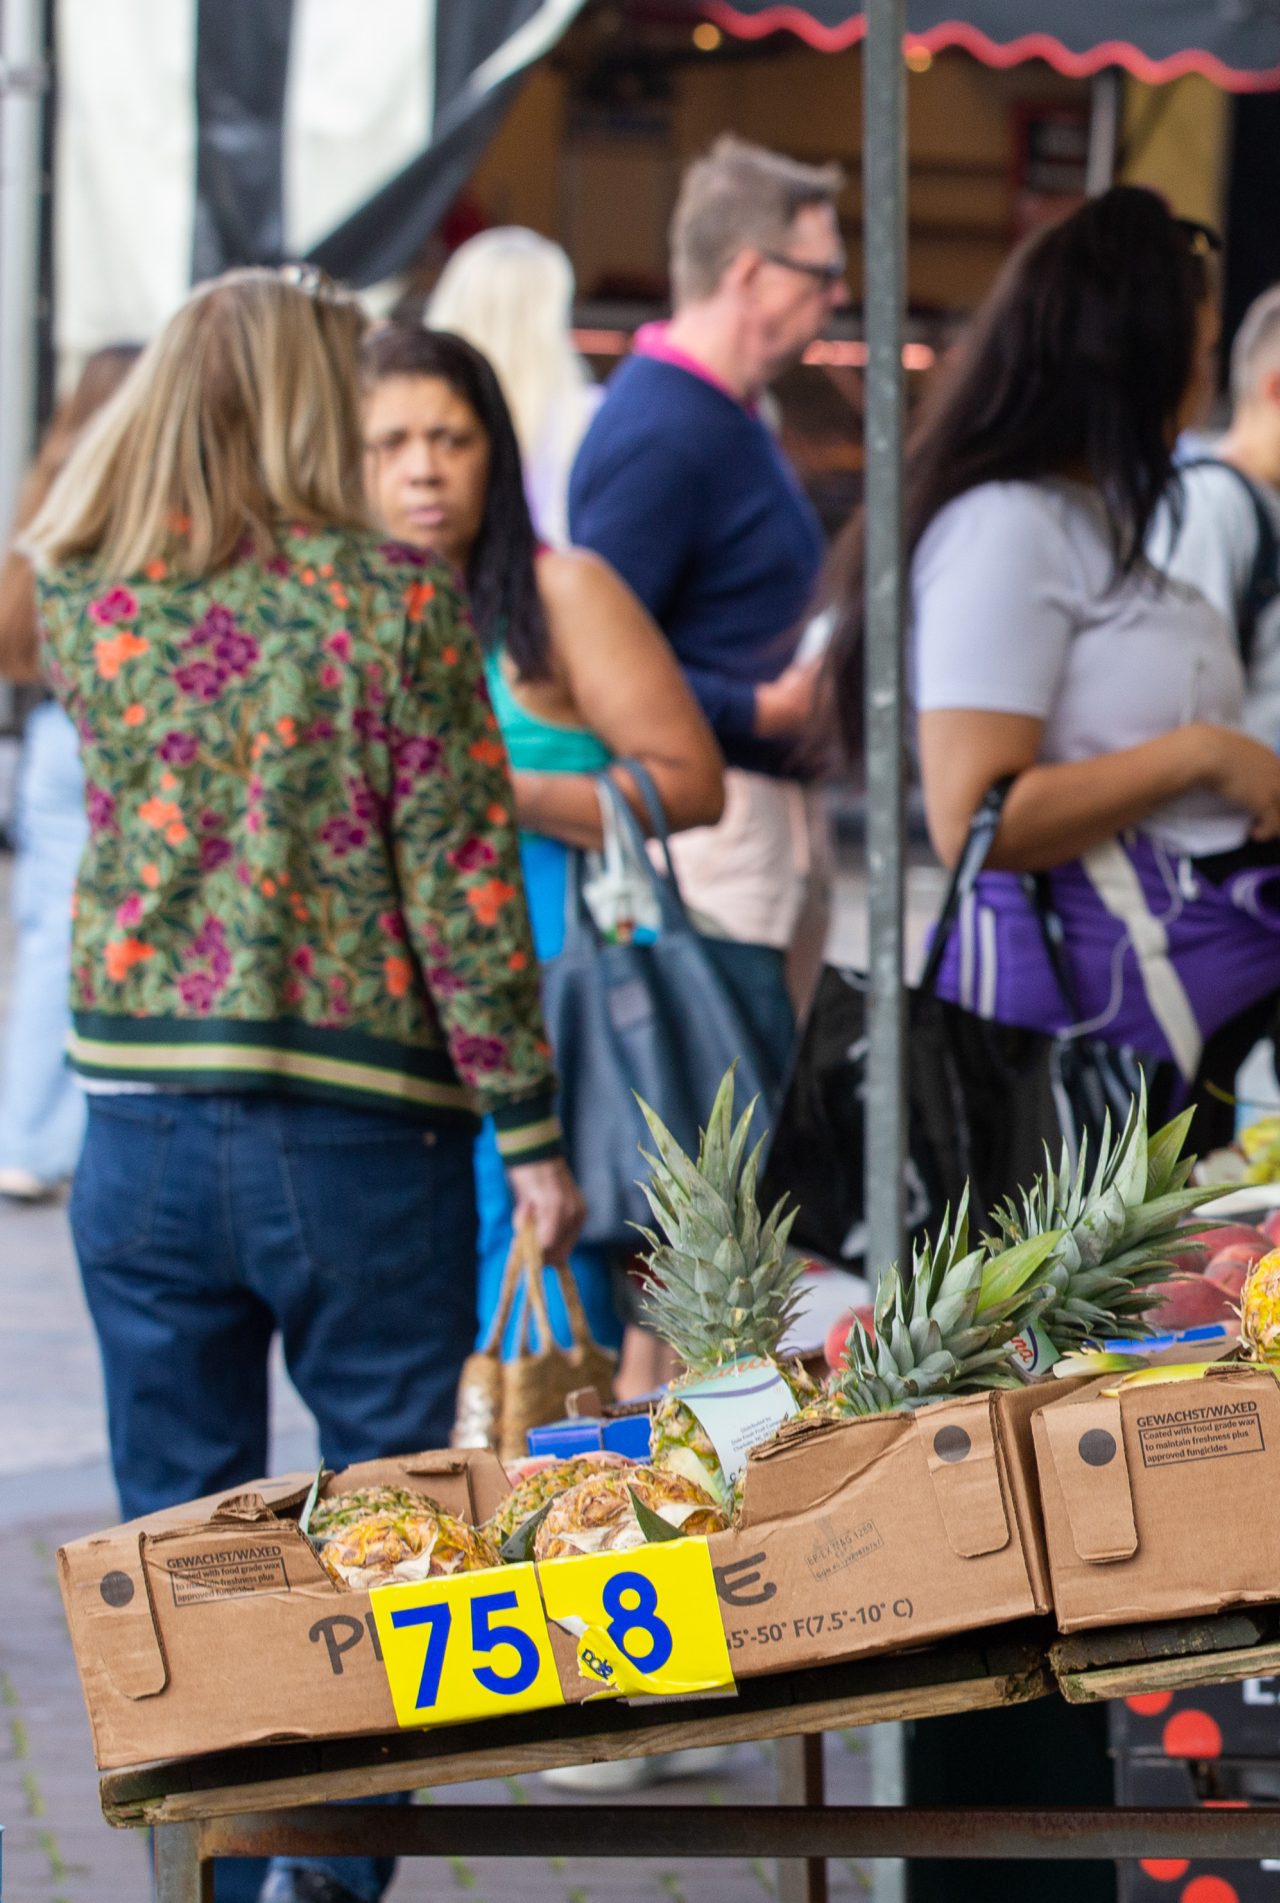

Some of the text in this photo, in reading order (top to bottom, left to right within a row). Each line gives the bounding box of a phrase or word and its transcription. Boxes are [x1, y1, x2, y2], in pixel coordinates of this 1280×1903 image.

[1136, 1401, 1257, 1428] GEWACHST/WAXED
[1143, 1429, 1172, 1441] Coated
[1173, 1427, 1192, 1437] with
[1193, 1424, 1213, 1433] food
[1214, 1421, 1237, 1432] grade
[1145, 1430, 1249, 1452] to maintain freshness plus
[1146, 1444, 1228, 1463] approved fungicides
[166, 1546, 282, 1569] GEWACHST/WAXED
[203, 1566, 220, 1577] with
[221, 1564, 240, 1575] food
[241, 1563, 263, 1574] grade
[264, 1561, 281, 1569] wax
[175, 1582, 184, 1591] to
[258, 1572, 275, 1583] plus
[893, 1598, 914, 1619] C)
[602, 1571, 673, 1675] 8
[391, 1590, 540, 1710] 75
